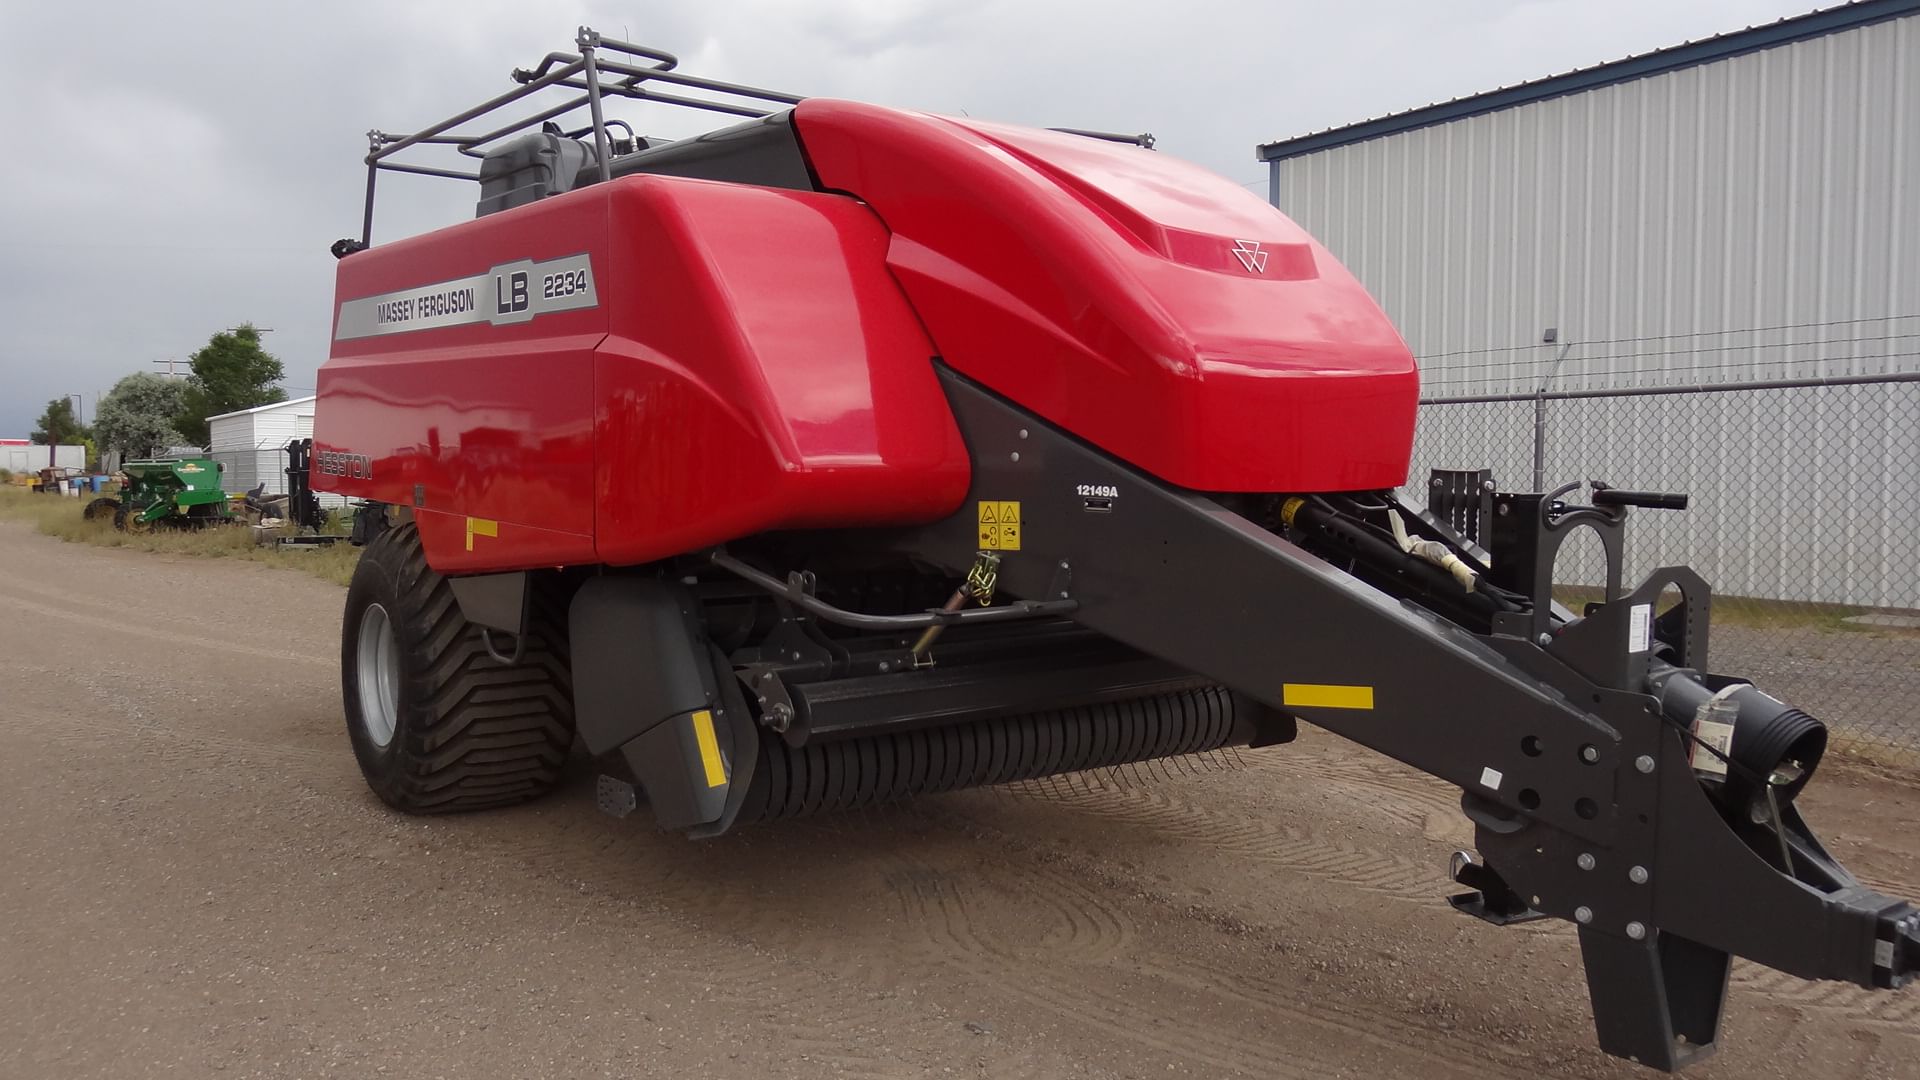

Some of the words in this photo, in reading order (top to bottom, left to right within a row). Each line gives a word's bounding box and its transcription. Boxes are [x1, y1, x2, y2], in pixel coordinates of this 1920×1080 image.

[377, 299, 415, 324] MASSEY
[418, 288, 474, 319] FERGUSON
[497, 271, 529, 315] LB
[544, 268, 587, 299] 2234
[316, 450, 373, 480] HESSTON
[1076, 484, 1119, 498] 12149A
